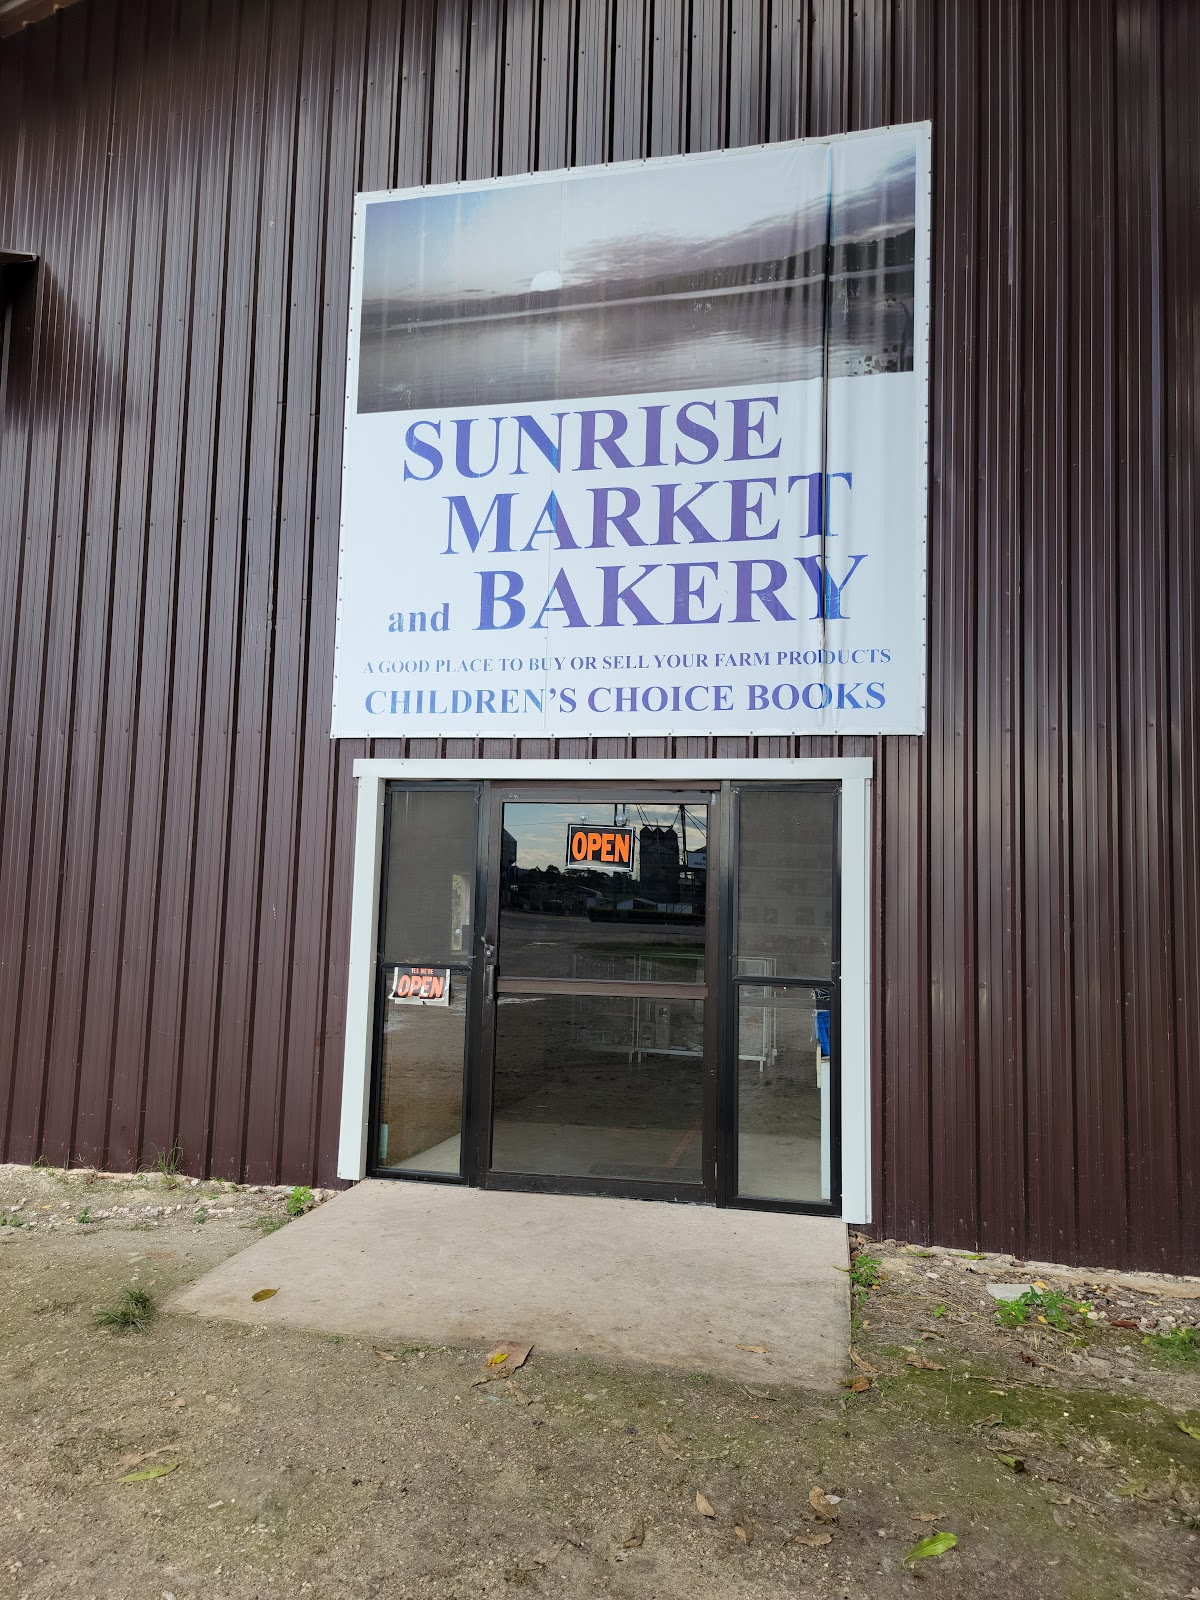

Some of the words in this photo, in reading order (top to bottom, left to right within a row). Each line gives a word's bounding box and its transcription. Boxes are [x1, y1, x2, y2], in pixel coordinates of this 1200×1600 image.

[404, 396, 782, 482] SUNRISE
[440, 472, 854, 555] MARKET
[387, 602, 450, 633] and
[472, 554, 869, 632] BAKERY
[363, 661, 374, 674] A
[378, 659, 430, 673] GOOD
[435, 658, 493, 673] PLACE
[499, 658, 523, 672] TO
[529, 656, 566, 671] BUY
[570, 656, 598, 670] OR
[602, 655, 650, 670] SELL
[654, 653, 709, 668] YOUR
[714, 652, 771, 667] FARM
[776, 648, 892, 666] PRODUCTS
[364, 687, 577, 715] CHILDREN'S
[587, 684, 735, 712] CHOICE
[745, 681, 886, 711] BOOKS
[571, 831, 630, 863] OPEN
[397, 974, 445, 998] OPEN
